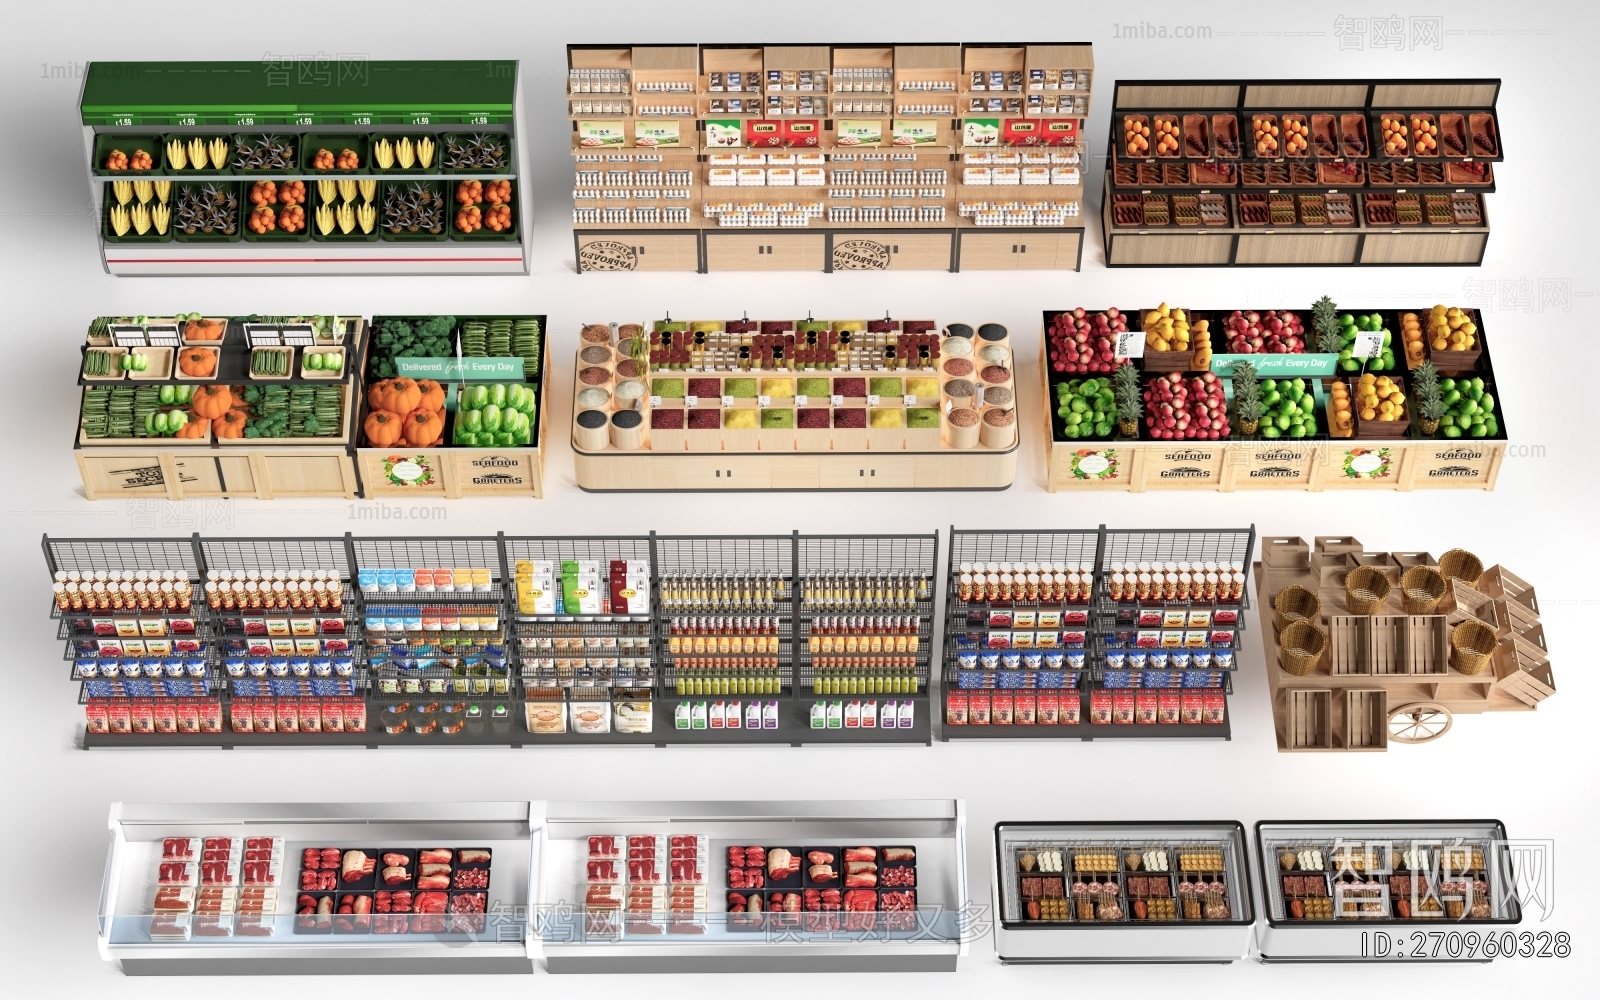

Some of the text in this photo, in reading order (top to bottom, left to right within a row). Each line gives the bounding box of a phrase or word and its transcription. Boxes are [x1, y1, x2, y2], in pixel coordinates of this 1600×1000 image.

[402, 362, 442, 371] Delivered
[472, 362, 496, 372] Every
[498, 362, 514, 372] Day
[1257, 357, 1284, 370] fresh
[1286, 359, 1309, 368] Every
[1310, 359, 1328, 368] Day
